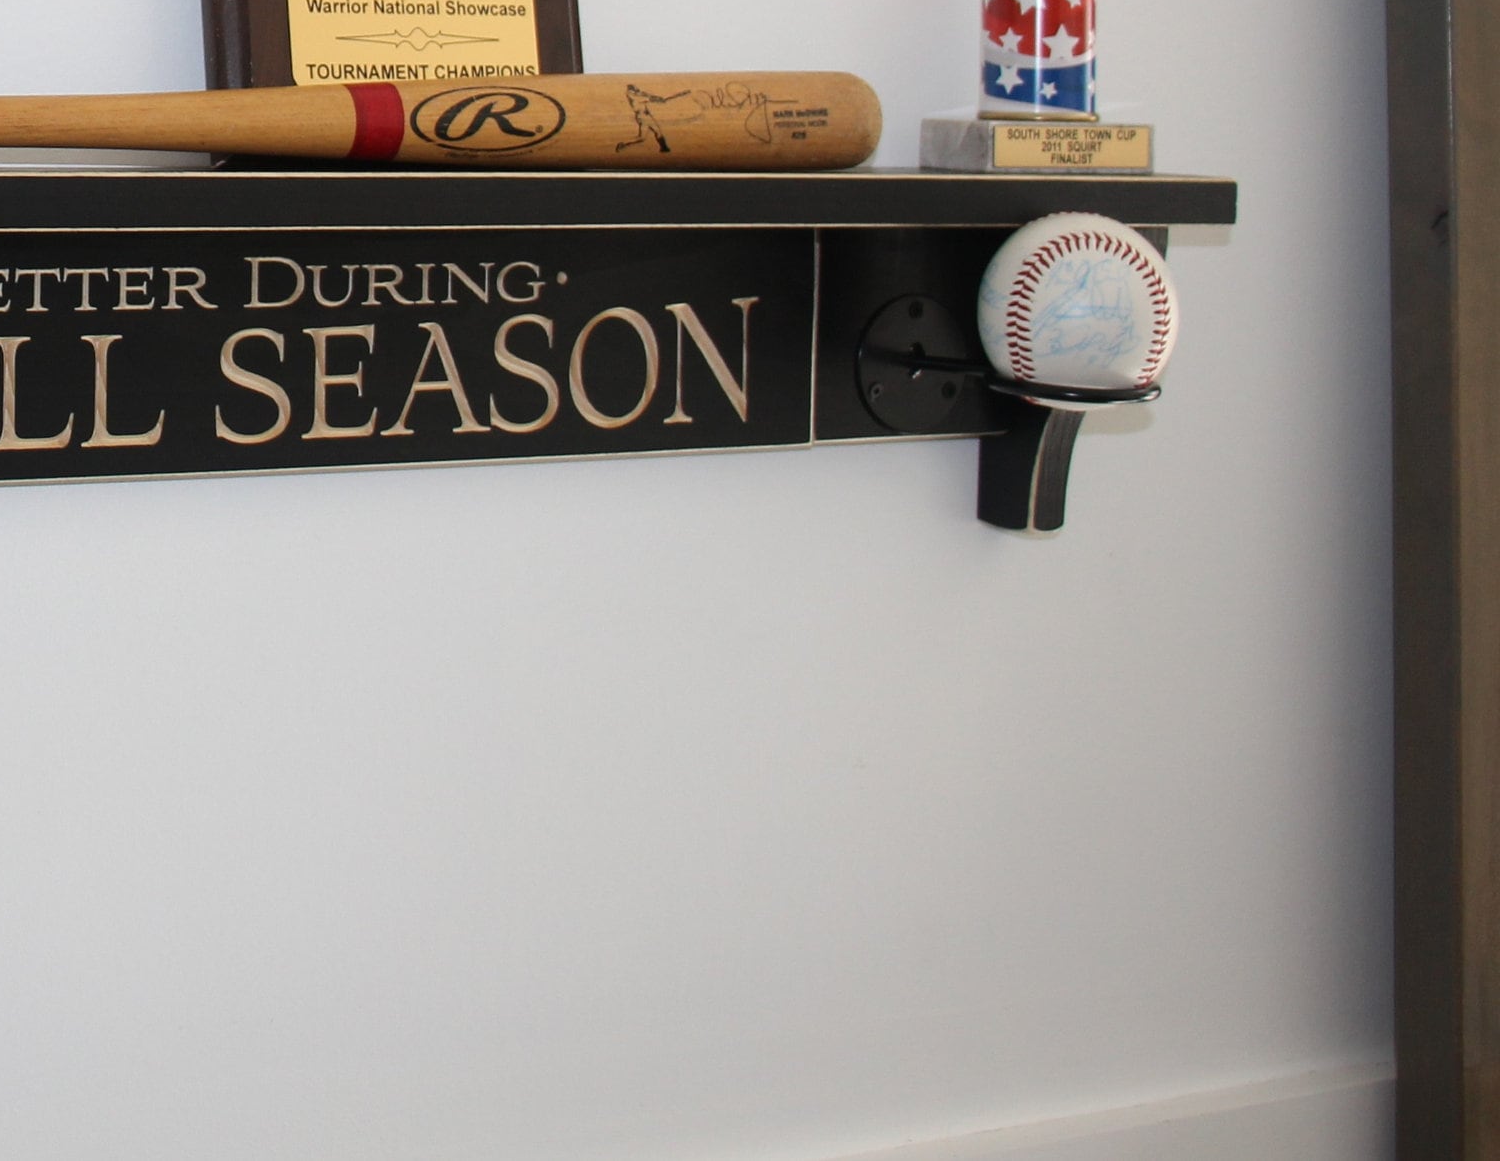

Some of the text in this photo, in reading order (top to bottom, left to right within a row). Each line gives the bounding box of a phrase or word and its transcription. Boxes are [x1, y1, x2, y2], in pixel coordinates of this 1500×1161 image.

[374, 0, 440, 15] National
[446, 0, 526, 16] Showcase
[306, 64, 536, 80] TOURNAMENT CHAMPIONS
[1007, 128, 1136, 140] SOUTH SHORE TOWN CUP
[1041, 140, 1102, 153] 2011 SQUIRT
[1050, 153, 1093, 164] FINALIST
[215, 296, 760, 445] SEASON
